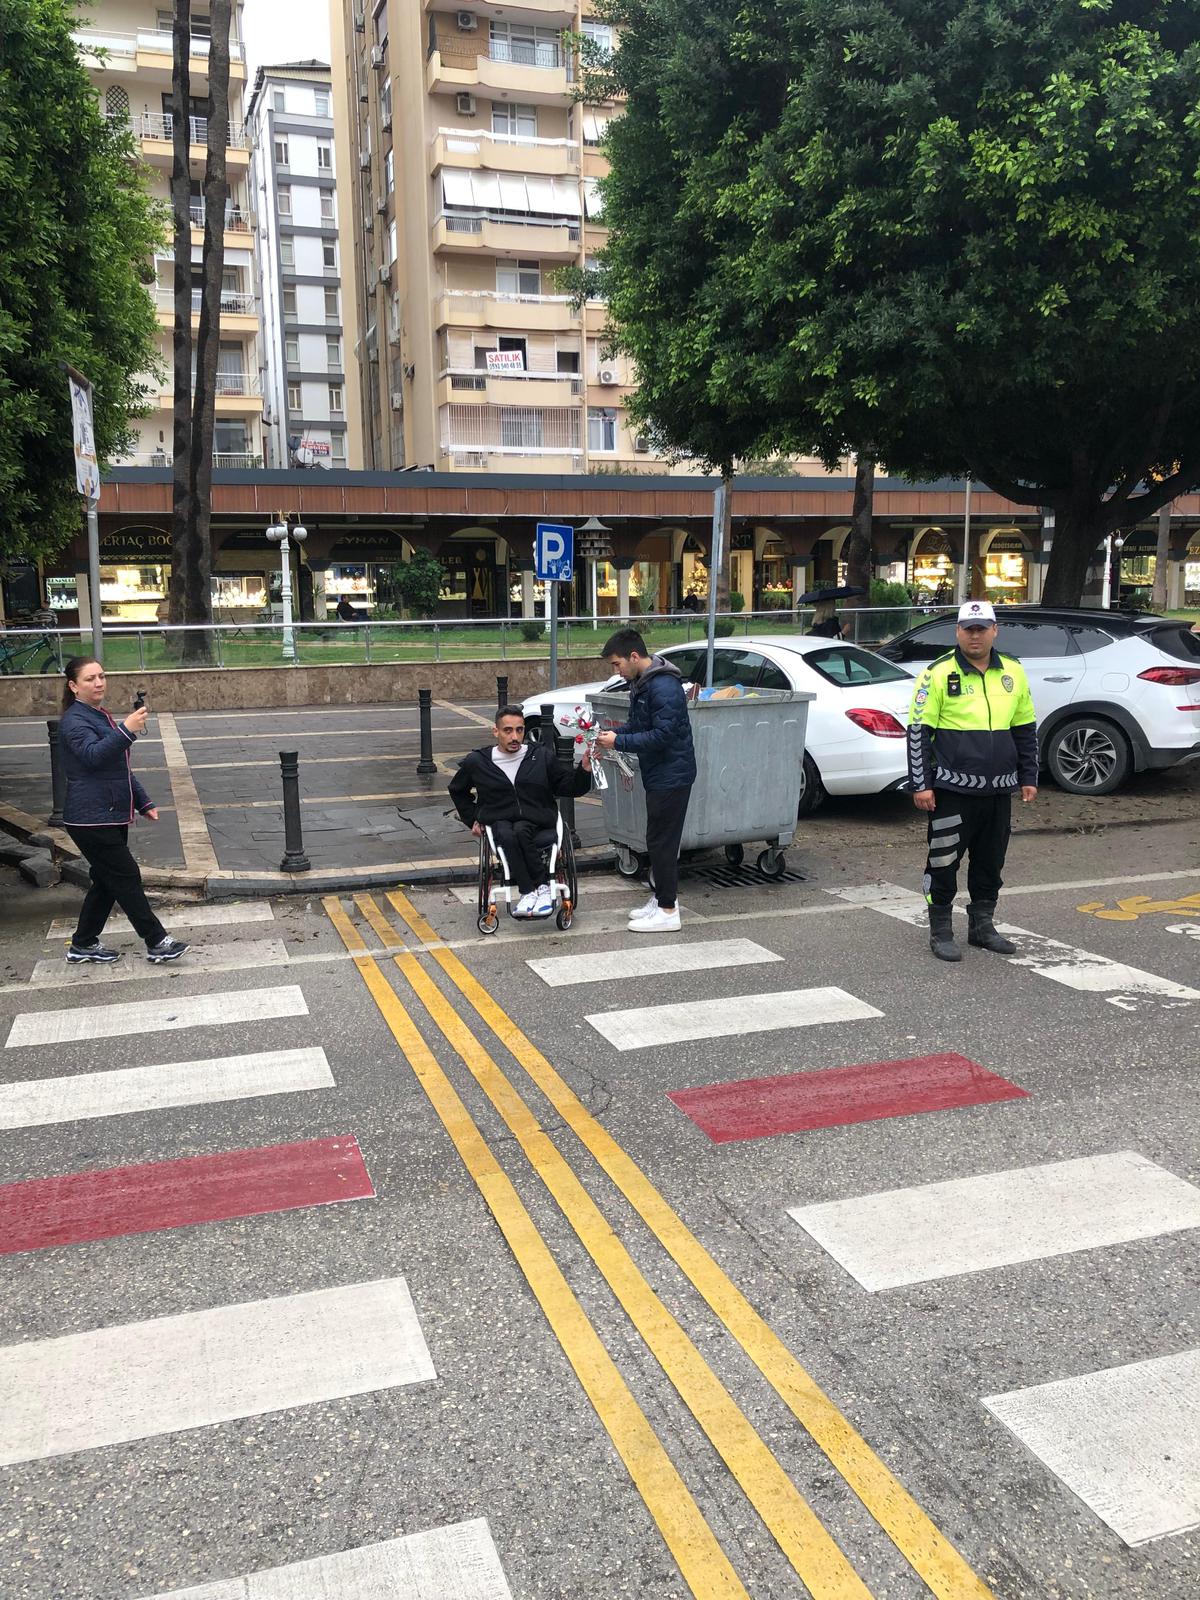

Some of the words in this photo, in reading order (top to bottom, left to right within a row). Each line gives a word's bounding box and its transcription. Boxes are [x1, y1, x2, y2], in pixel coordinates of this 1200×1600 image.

[488, 354, 521, 363] SATILIK
[102, 535, 145, 549] ERTAÇ
[335, 536, 390, 545] EYHAN
[541, 531, 565, 575] P
